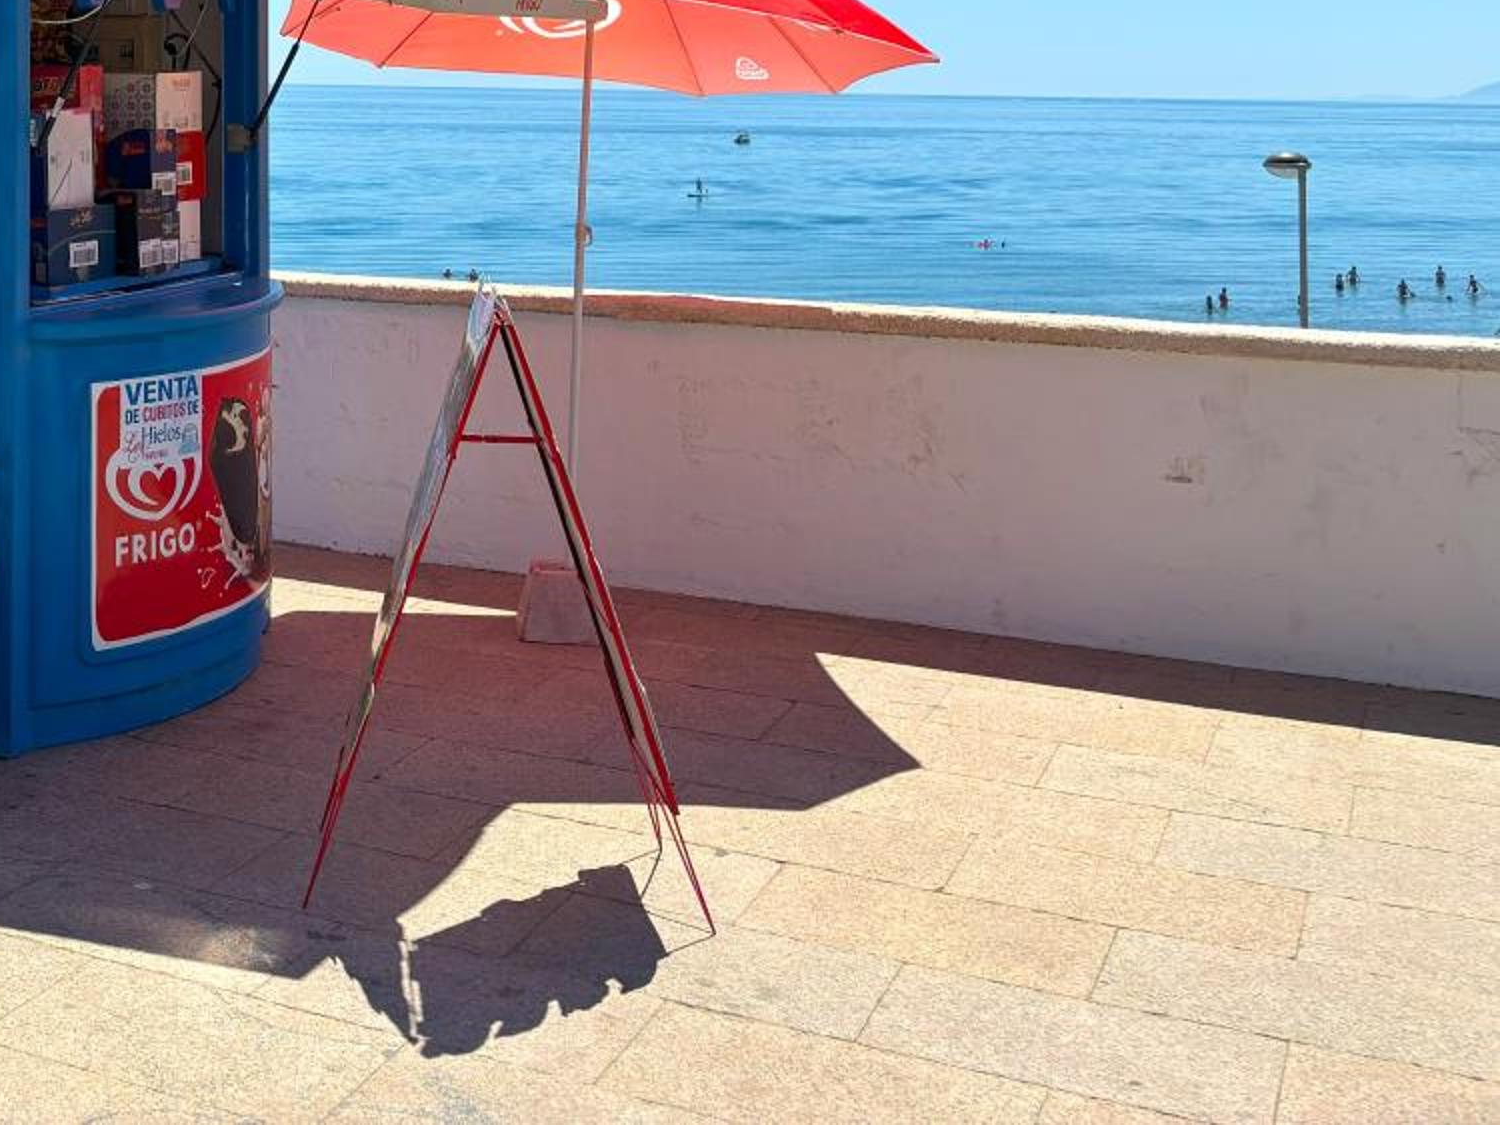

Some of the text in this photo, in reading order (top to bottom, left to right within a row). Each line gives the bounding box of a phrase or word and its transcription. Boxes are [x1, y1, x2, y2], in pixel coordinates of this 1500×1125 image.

[125, 374, 199, 406] VENTA
[125, 398, 199, 425] DE CUBITOS DE
[115, 522, 196, 568] FRIGO
